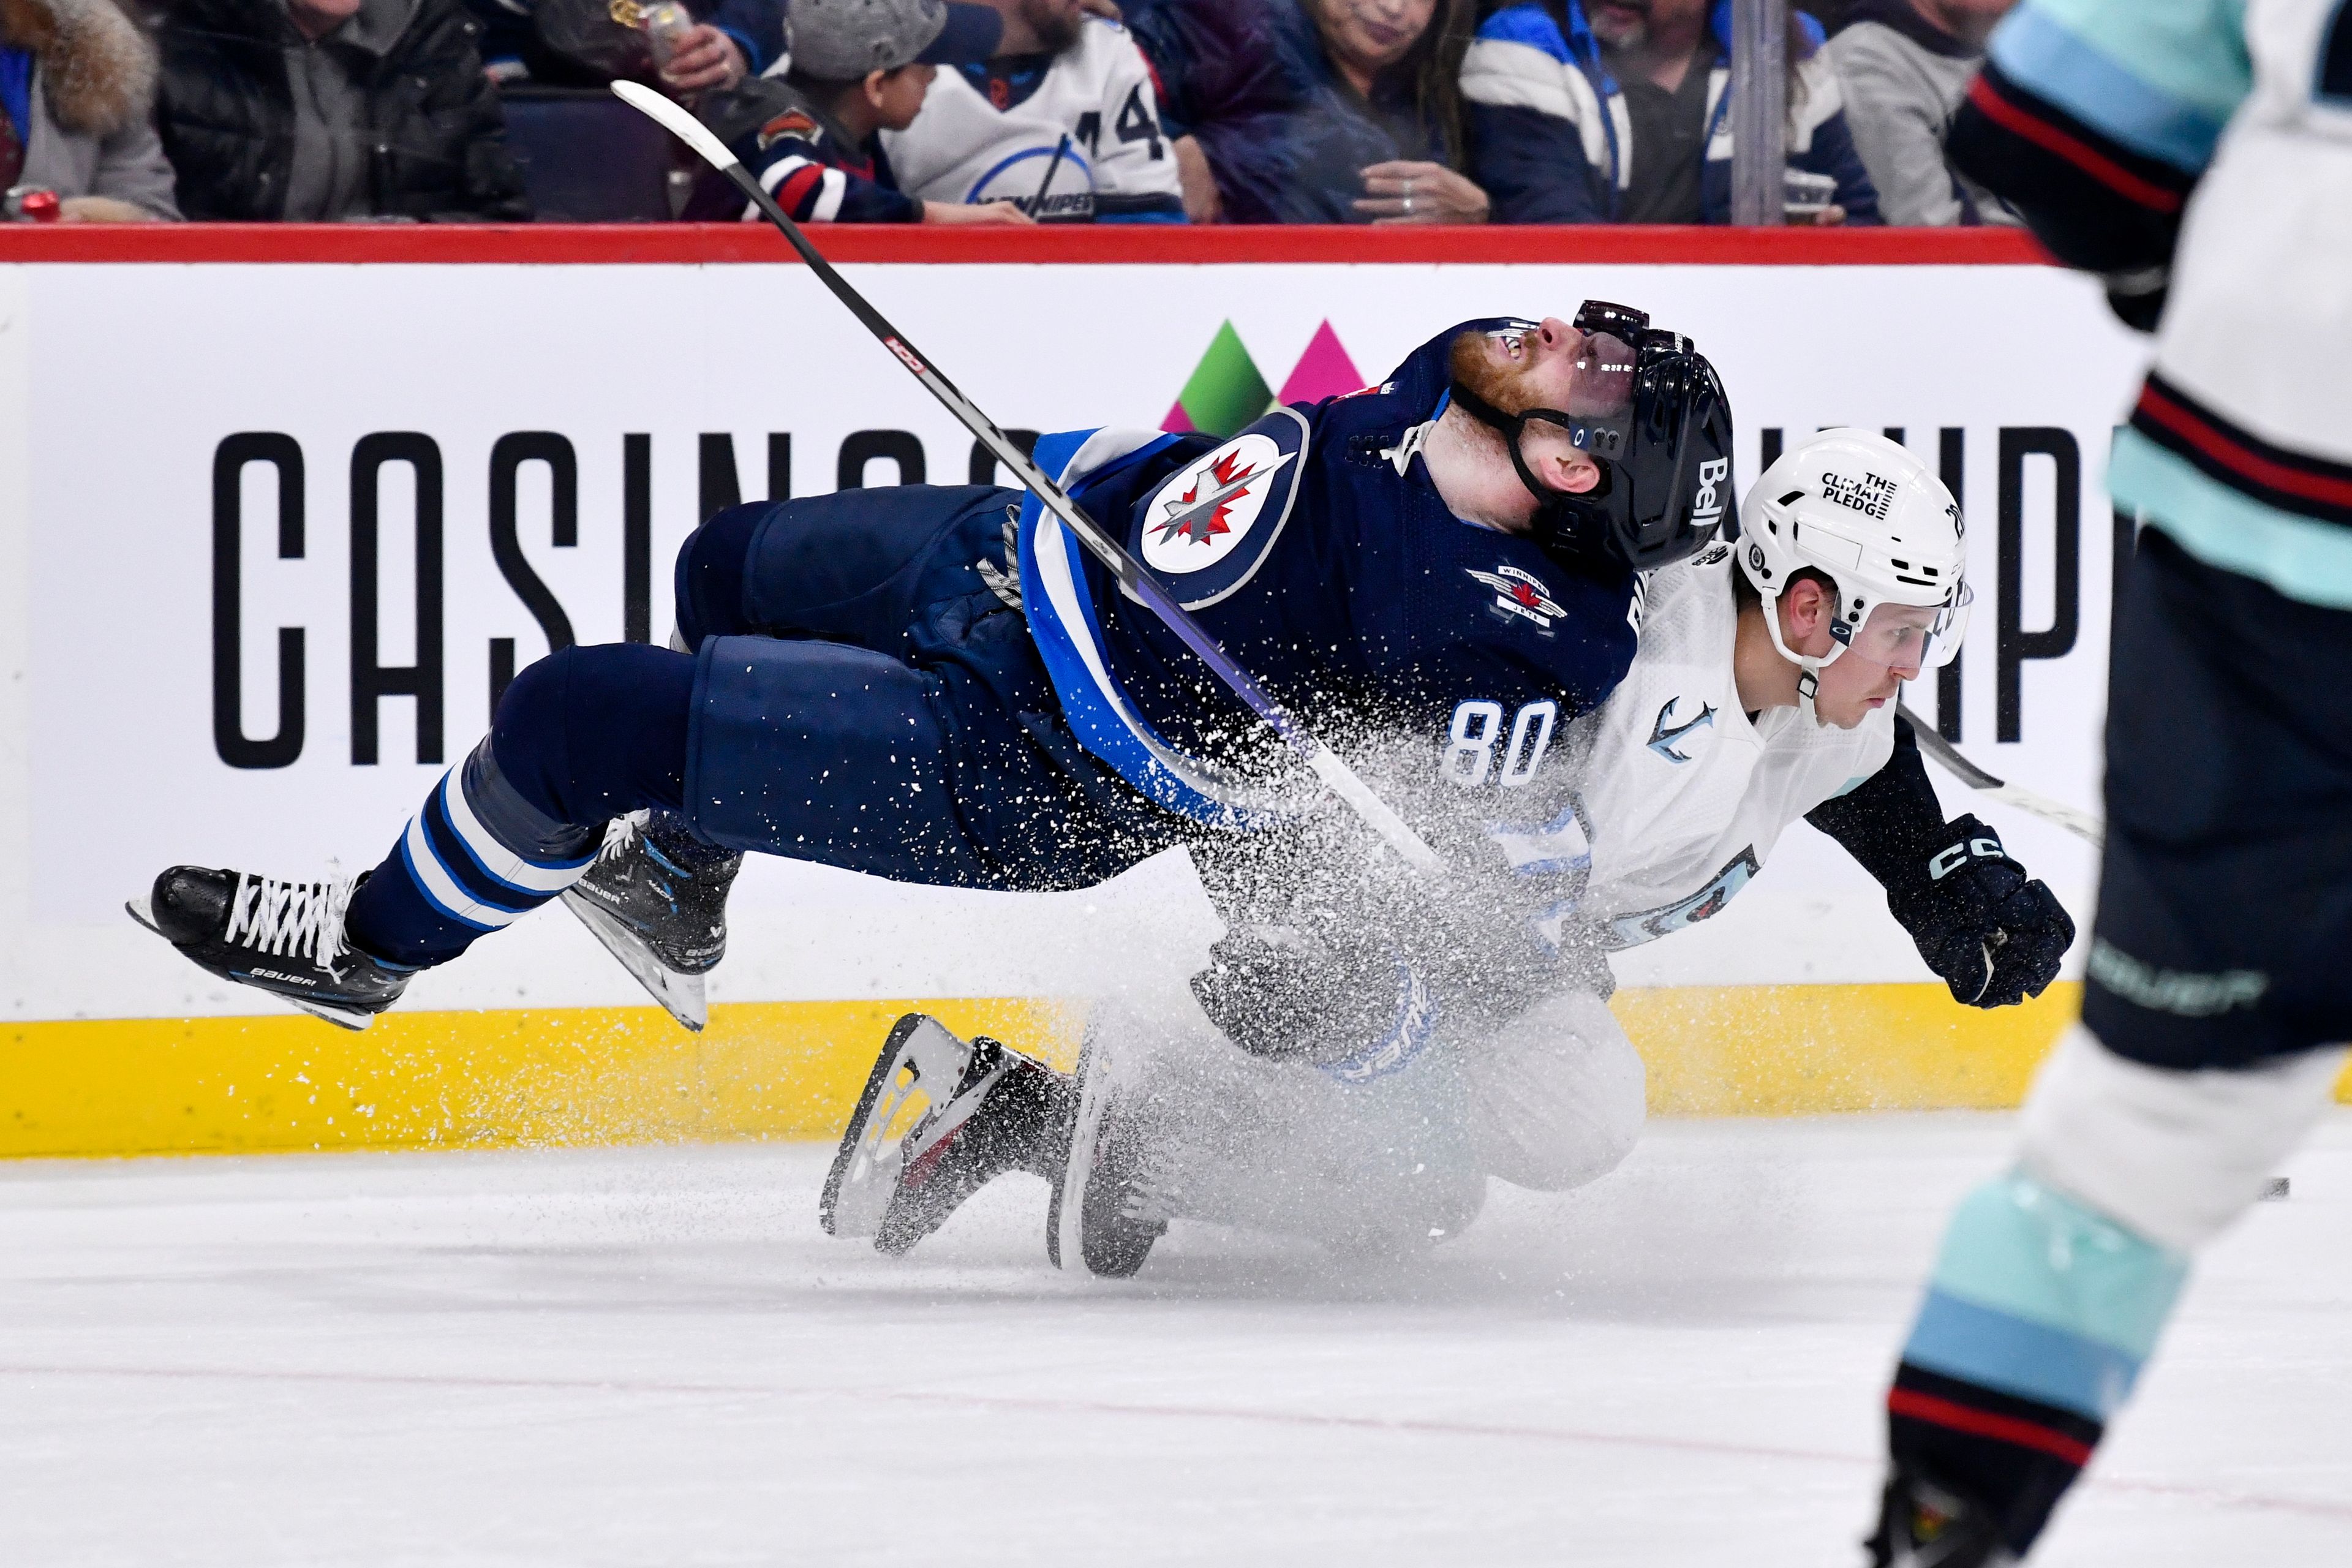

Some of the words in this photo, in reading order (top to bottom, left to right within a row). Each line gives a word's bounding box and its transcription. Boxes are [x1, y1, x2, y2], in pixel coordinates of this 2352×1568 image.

[1690, 456, 1728, 526] Bell
[1823, 487, 1888, 520] PLEDGE
[1866, 472, 1897, 494] THE
[213, 431, 1045, 769] CASI
[1513, 605, 1538, 620] JETS
[1441, 699, 1556, 786] 80
[1929, 838, 2004, 880] CC
